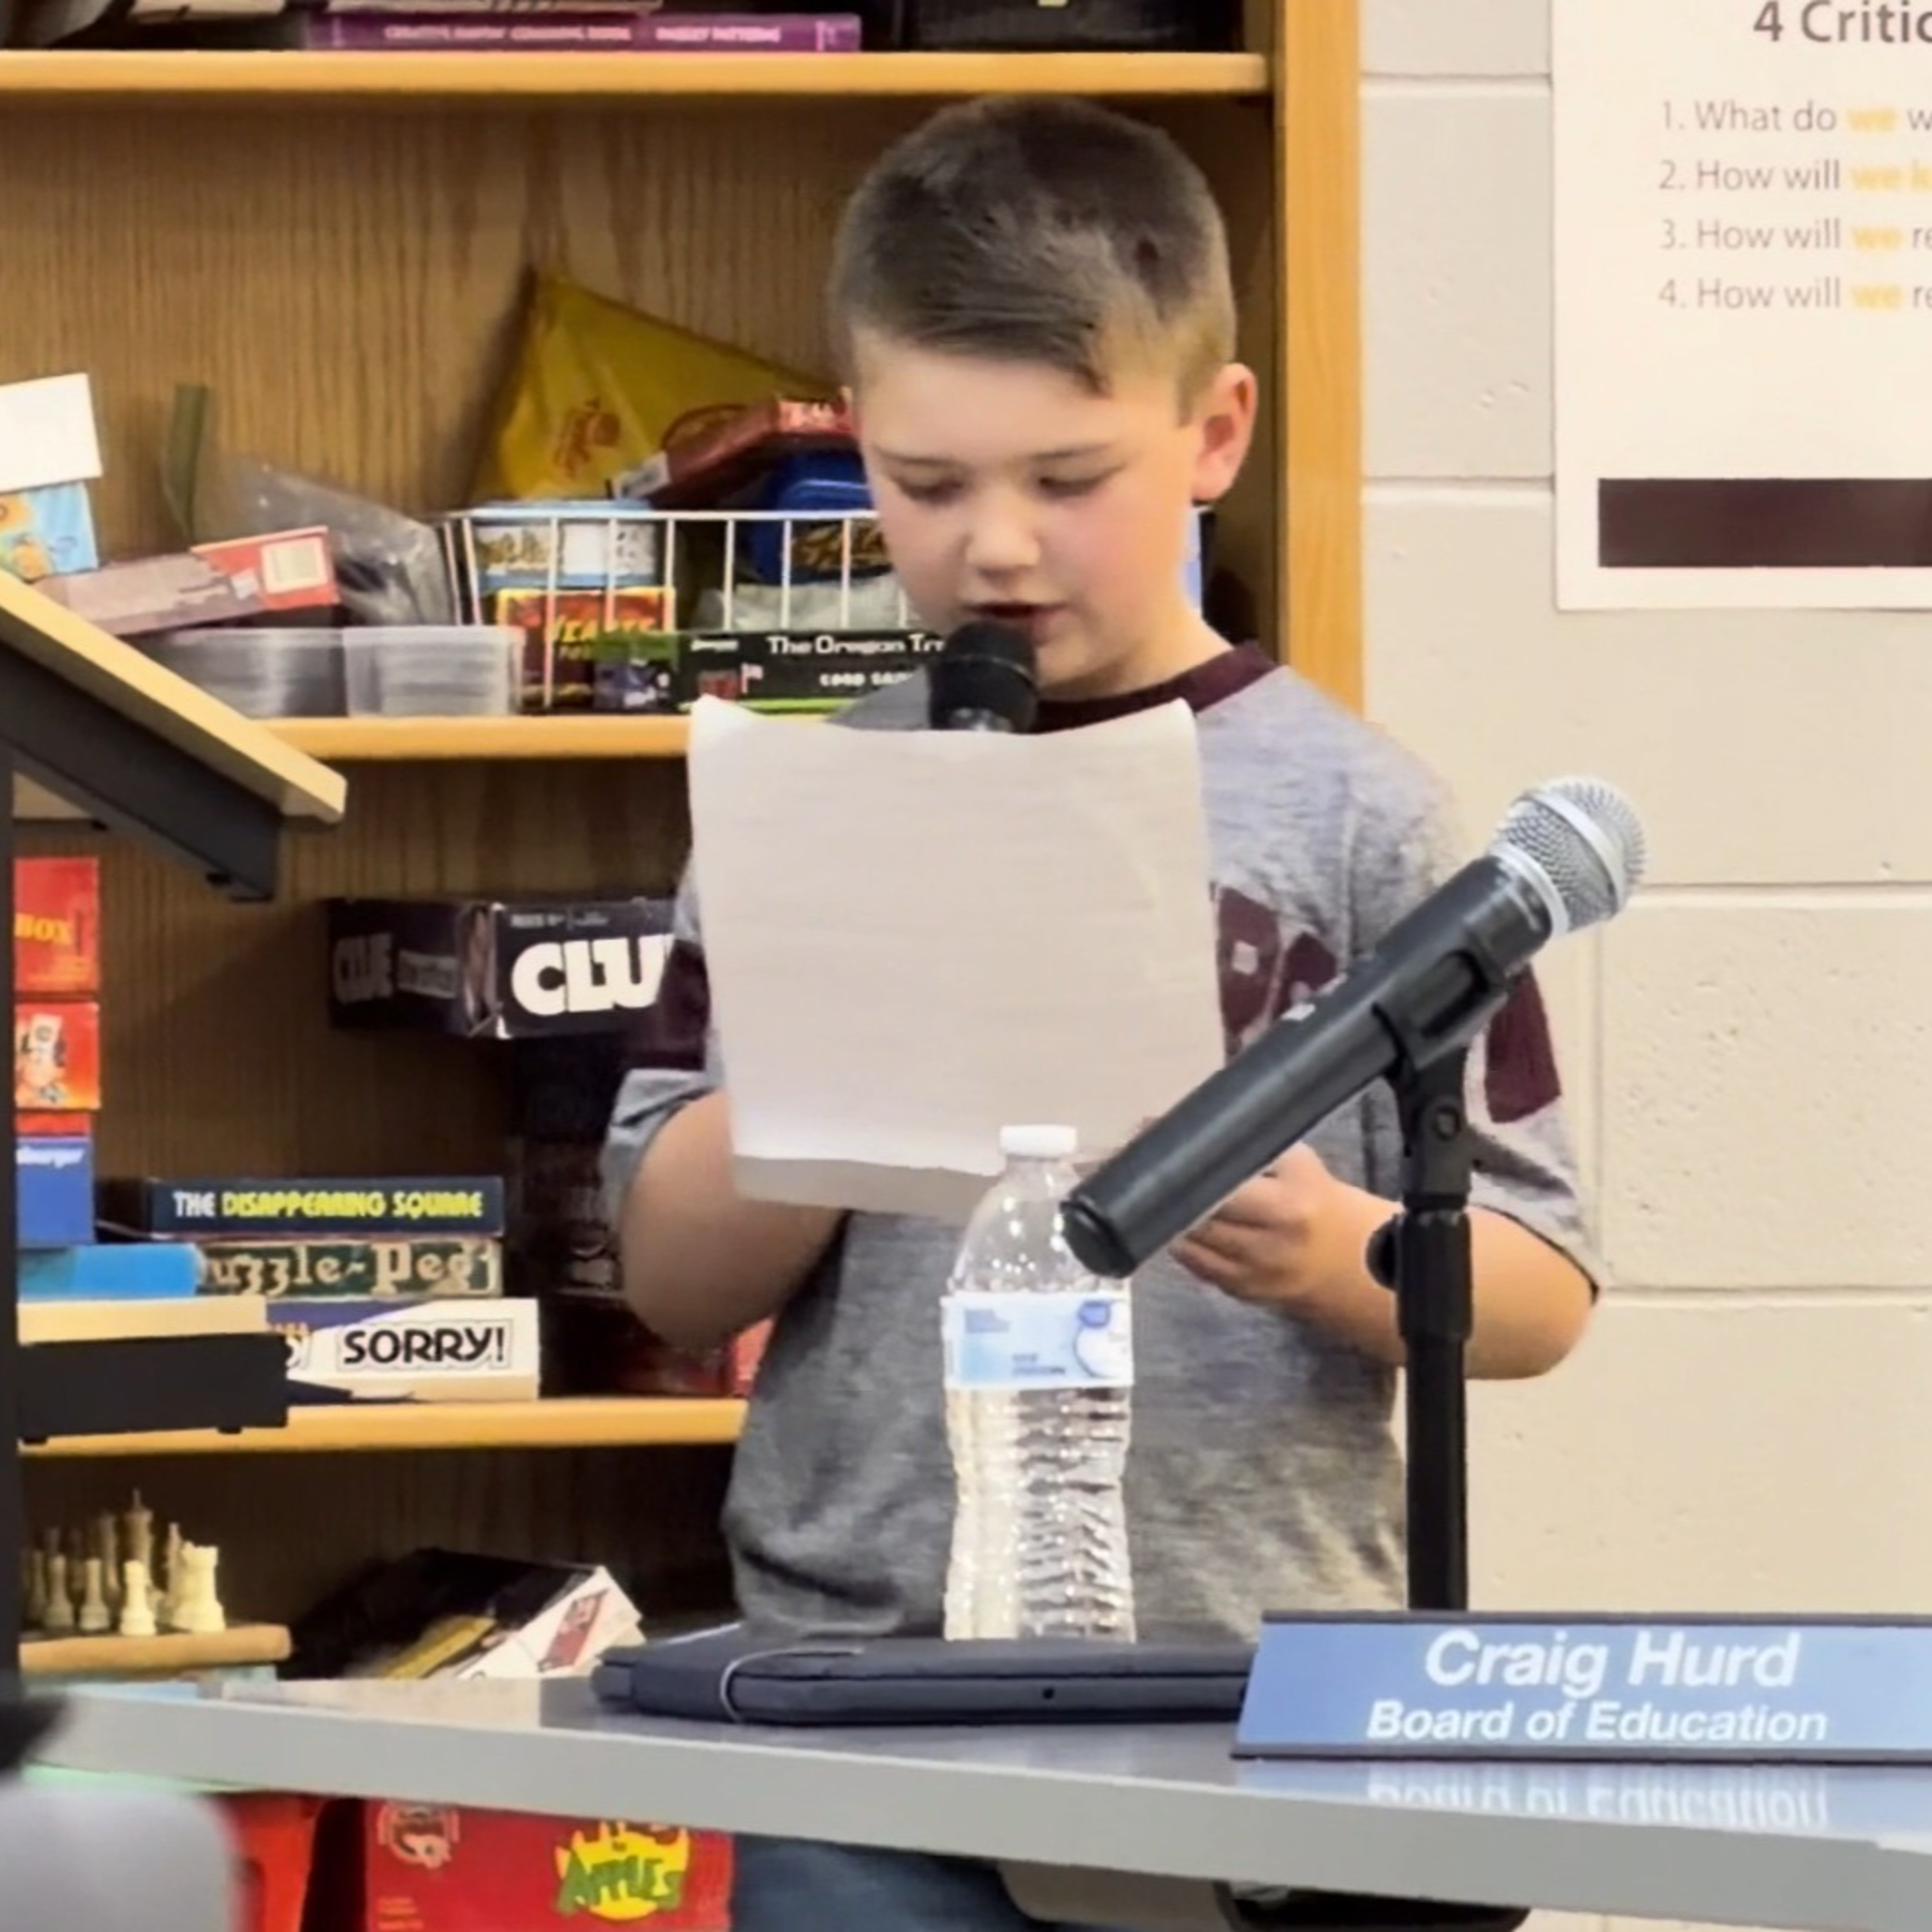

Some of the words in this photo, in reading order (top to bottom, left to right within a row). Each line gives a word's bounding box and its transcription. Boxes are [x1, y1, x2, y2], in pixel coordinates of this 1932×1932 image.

[1753, 0, 1784, 42] 4
[1801, 0, 1932, 43] Critic
[1662, 100, 1685, 130] 1.
[1695, 100, 1782, 131] What
[1793, 100, 1837, 131] do
[1846, 107, 1897, 131] we
[1658, 160, 1686, 190] 2.
[1696, 160, 1774, 191] How
[1783, 158, 1840, 190] will
[1850, 166, 1902, 191] we
[1660, 219, 1687, 250] 3.
[1696, 219, 1774, 250] How
[1783, 218, 1841, 249] will
[1851, 225, 1903, 251] we
[1658, 278, 1687, 309] 4.
[1696, 278, 1774, 309] How
[1783, 277, 1841, 308] will
[1852, 285, 1904, 309] we
[767, 636, 811, 654] The
[815, 634, 905, 655] Oregon
[511, 933, 675, 1016] CLU
[173, 1190, 216, 1218] THE
[207, 1242, 478, 1297] uzzle-Peg
[343, 1326, 506, 1365] SORRY!
[1424, 1629, 1609, 1698] Craig
[1626, 1632, 1801, 1689] Hurd
[1366, 1700, 1515, 1741] Board
[1524, 1701, 1575, 1740] of
[1586, 1701, 1828, 1743] Education
